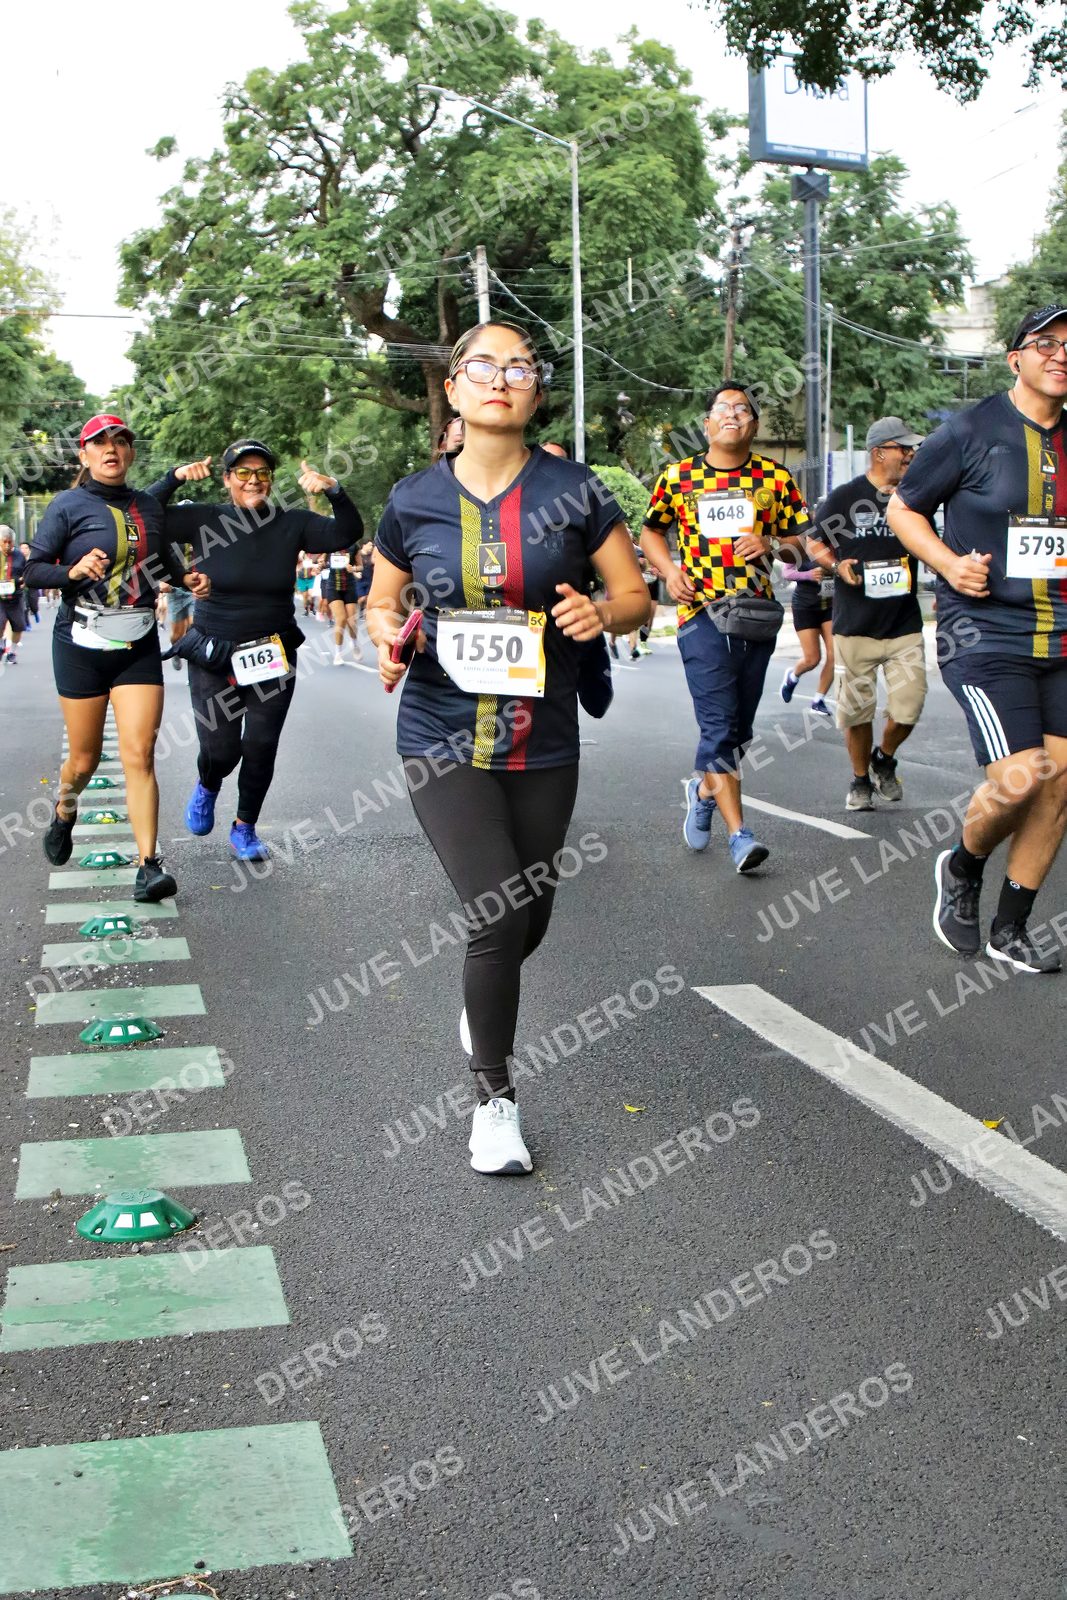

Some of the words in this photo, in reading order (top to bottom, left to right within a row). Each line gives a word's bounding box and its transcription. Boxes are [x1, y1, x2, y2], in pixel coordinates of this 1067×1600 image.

[707, 505, 744, 521] 4648
[1019, 536, 1065, 556] 5793
[871, 572, 901, 586] 3607
[452, 633, 523, 664] 1550
[239, 649, 274, 669] 1163
